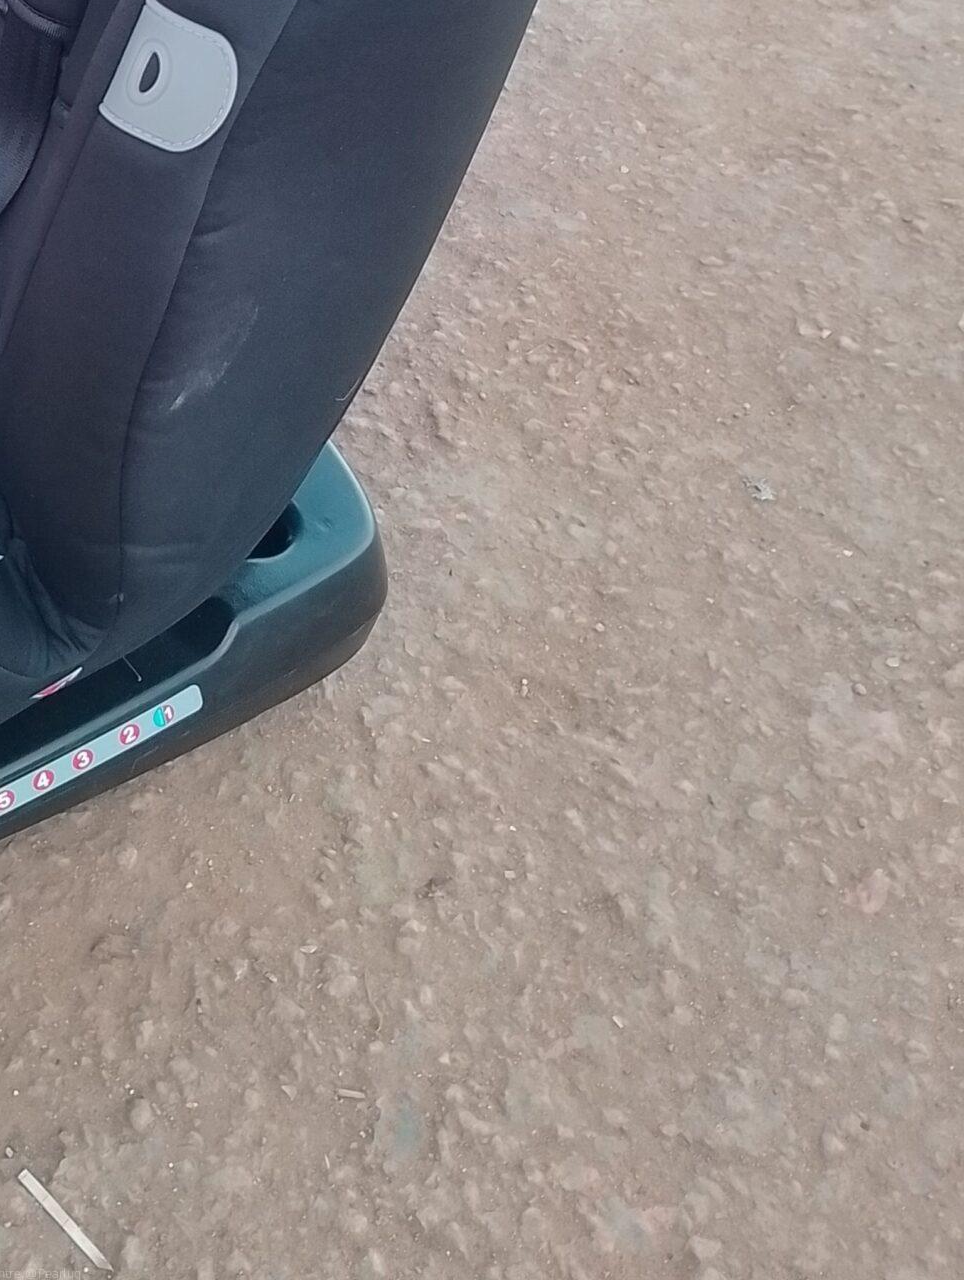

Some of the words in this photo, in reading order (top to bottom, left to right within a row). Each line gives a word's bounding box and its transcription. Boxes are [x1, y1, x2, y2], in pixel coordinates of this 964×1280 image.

[37, 772, 50, 787] 4
[77, 752, 89, 767] 3
[123, 726, 136, 743] 2
